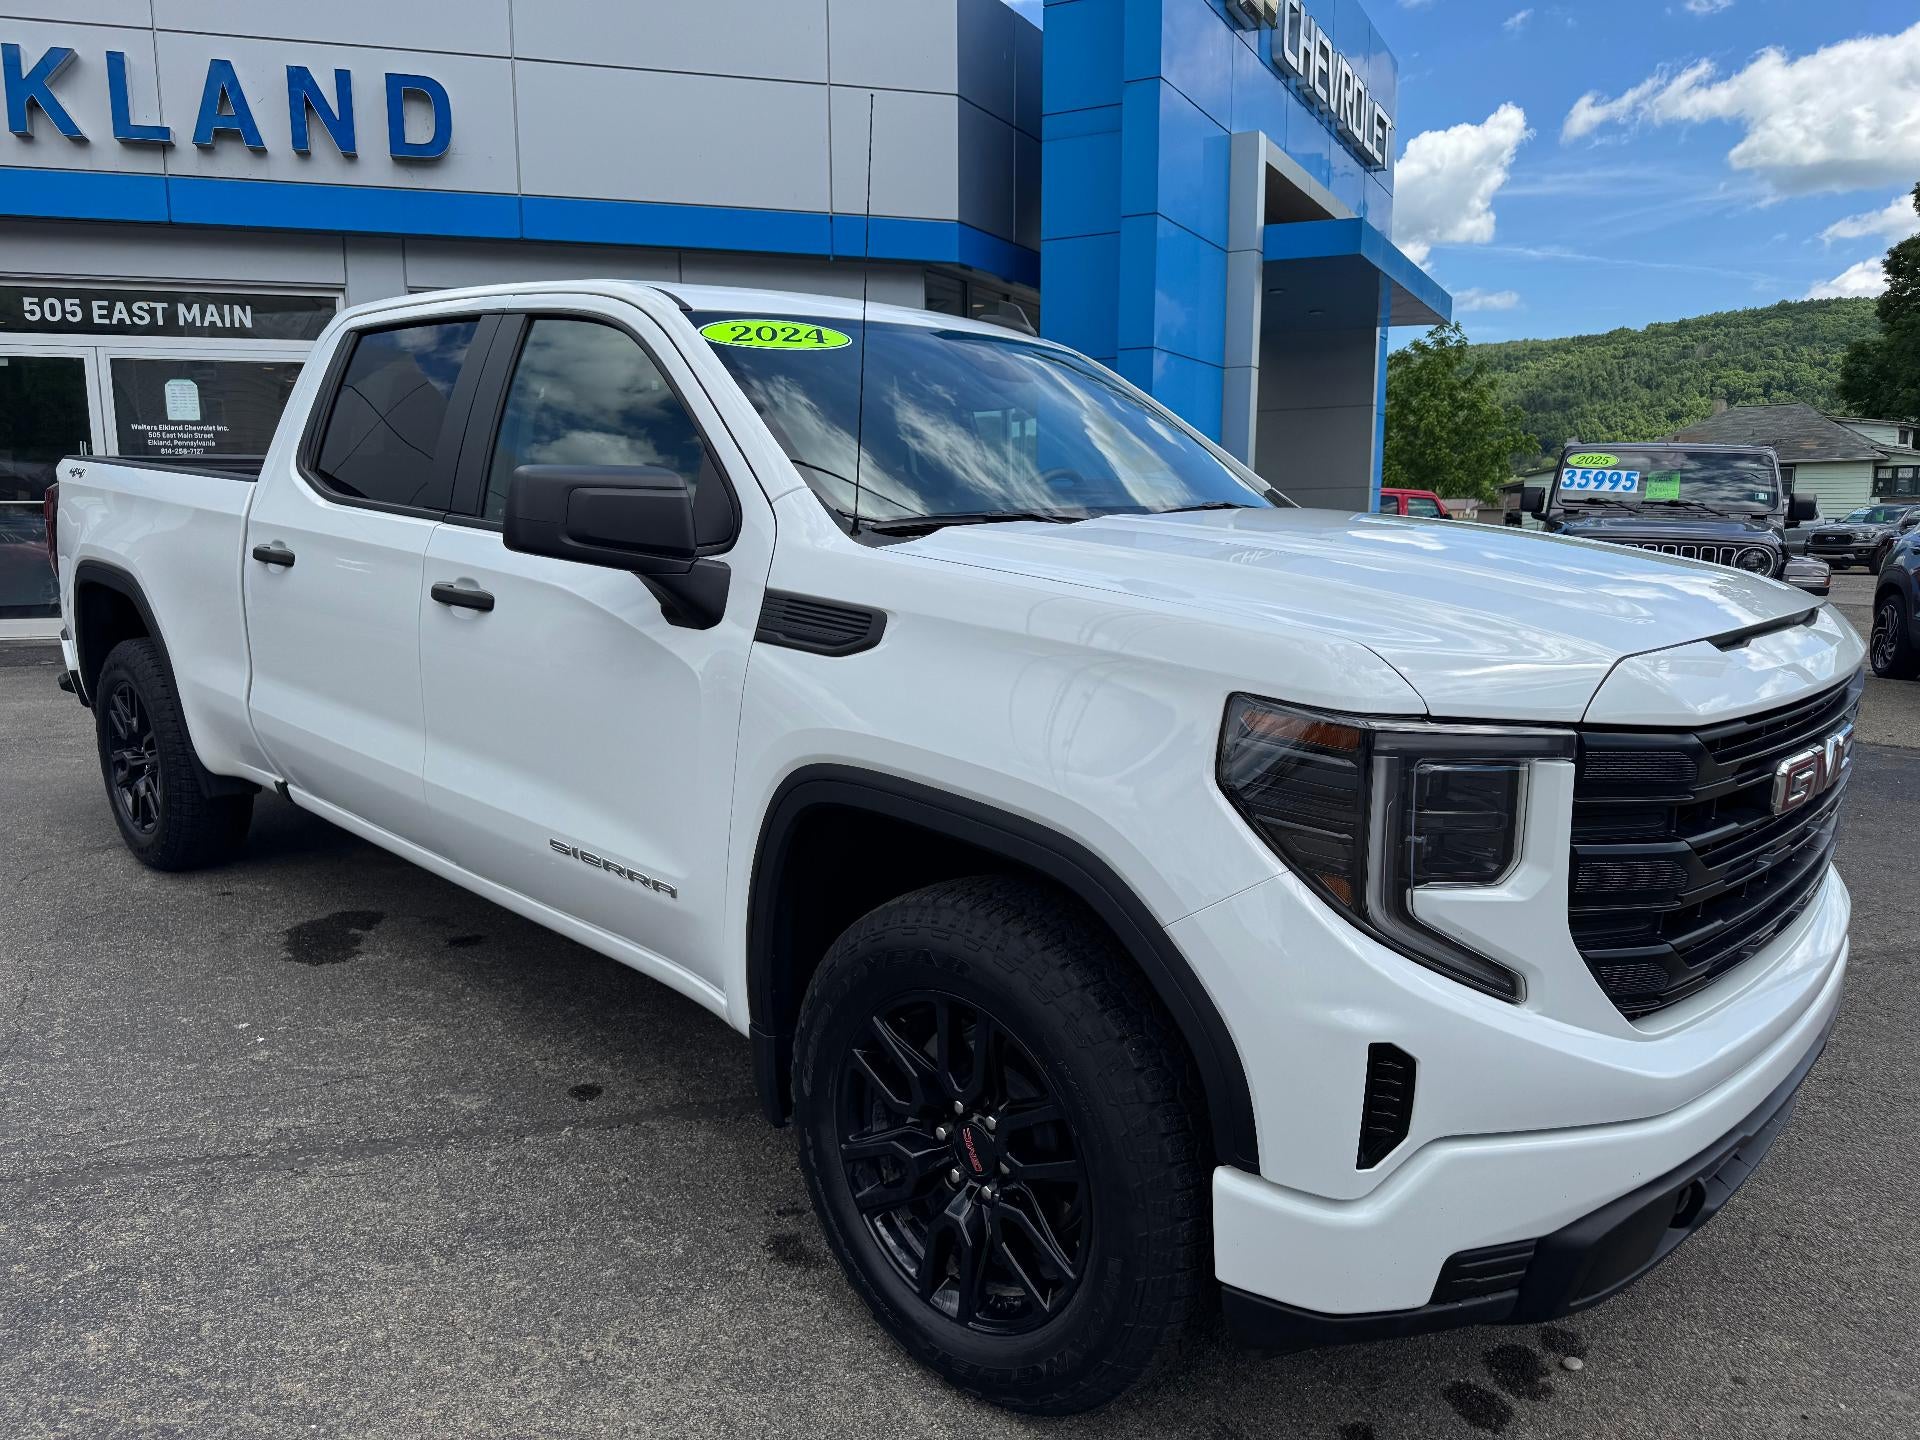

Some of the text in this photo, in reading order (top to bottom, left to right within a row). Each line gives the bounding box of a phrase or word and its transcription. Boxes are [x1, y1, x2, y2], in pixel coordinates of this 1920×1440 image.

[1276, 0, 1394, 170] CHEVROLET
[0, 42, 453, 161] KLAND
[23, 296, 253, 328] 505 EAST MAIN
[730, 325, 828, 344] 2024
[131, 423, 158, 431] Walters
[1576, 455, 1611, 465] 2025
[1562, 469, 1638, 491] 35995
[549, 838, 678, 899] SIERRA
[962, 1127, 983, 1172] GMC
